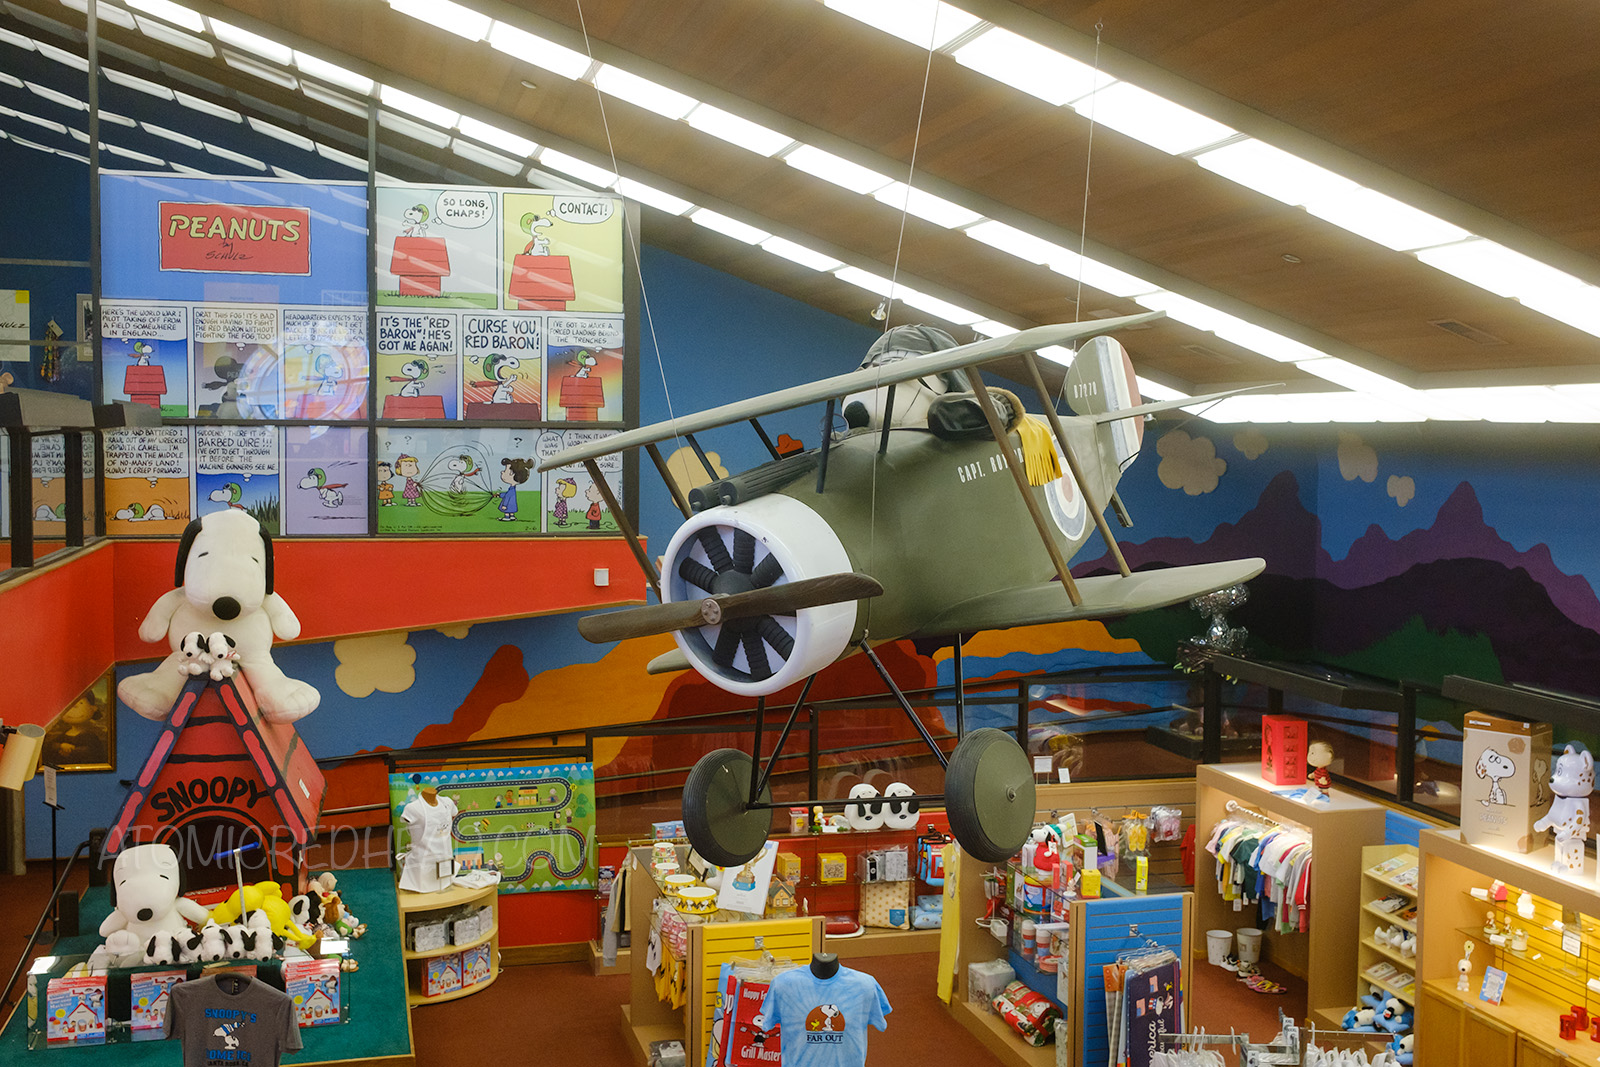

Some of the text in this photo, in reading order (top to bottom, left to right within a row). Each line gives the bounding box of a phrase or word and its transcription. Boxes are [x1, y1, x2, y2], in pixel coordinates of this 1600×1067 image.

[443, 198, 488, 210] SO LONG,
[559, 202, 608, 216] CONTACT!
[446, 209, 485, 219] CHAPS!
[168, 214, 301, 242] PEANUTS
[133, 323, 176, 331] SOMEWHERE
[380, 316, 450, 328] IT'S THE "RED
[468, 318, 539, 337] CURSE YOU,
[428, 330, 451, 340] HE'S
[379, 340, 453, 352] GOT ME AGAIN!
[465, 335, 540, 350] RED BARON!
[198, 438, 235, 448] BARBED
[237, 438, 260, 448] WIRE
[198, 447, 207, 455] I'VE
[957, 461, 986, 483] CAPT.
[151, 776, 270, 822] SNOOPY
[743, 988, 760, 1000] Happy
[205, 1008, 257, 1023] SNOOPY'S
[807, 1034, 843, 1042] FAR OUT
[741, 1045, 781, 1062] Grill Master
